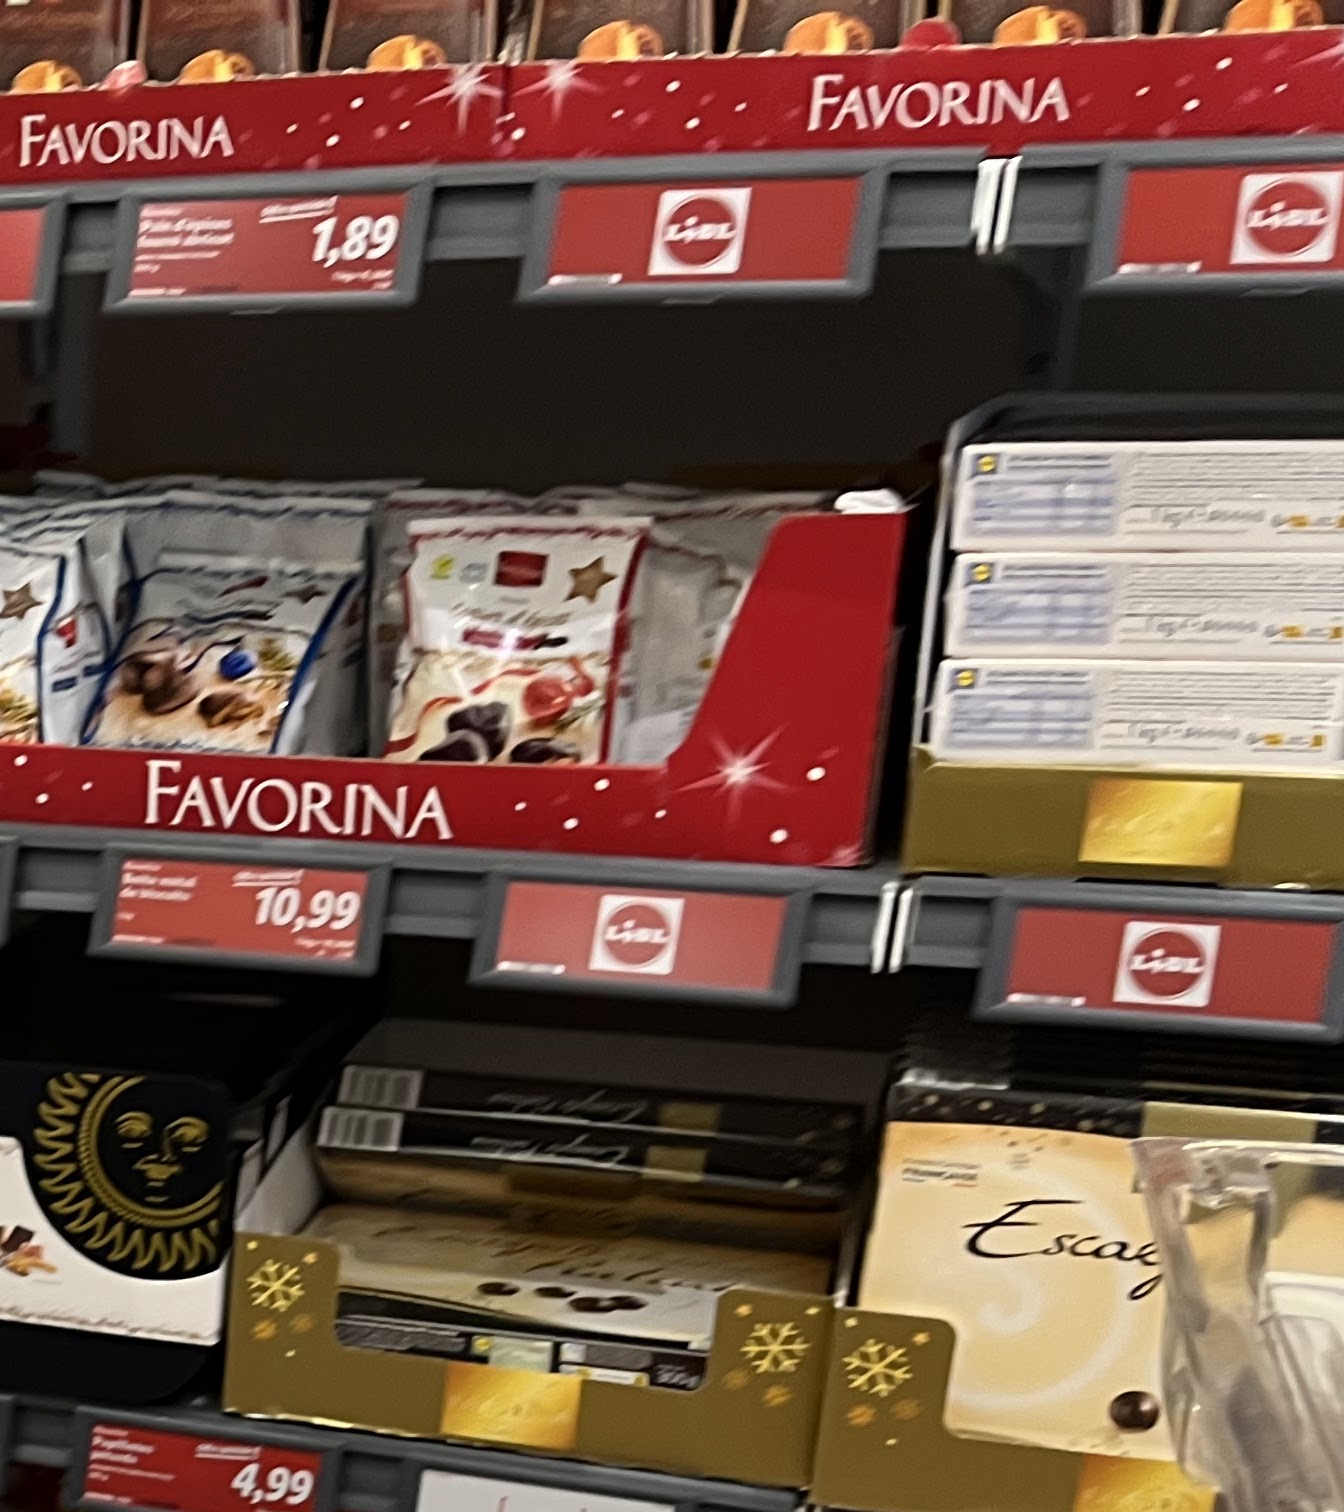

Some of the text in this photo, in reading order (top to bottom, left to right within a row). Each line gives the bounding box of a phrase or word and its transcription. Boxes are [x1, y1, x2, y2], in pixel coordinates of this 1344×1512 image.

[808, 74, 1070, 131] FAVORINA
[20, 114, 234, 168] FAVORINA
[313, 214, 400, 268] 1,89
[144, 759, 454, 841] FAVORINA
[255, 886, 361, 933] 10,99
[230, 1463, 314, 1505] 4,99
